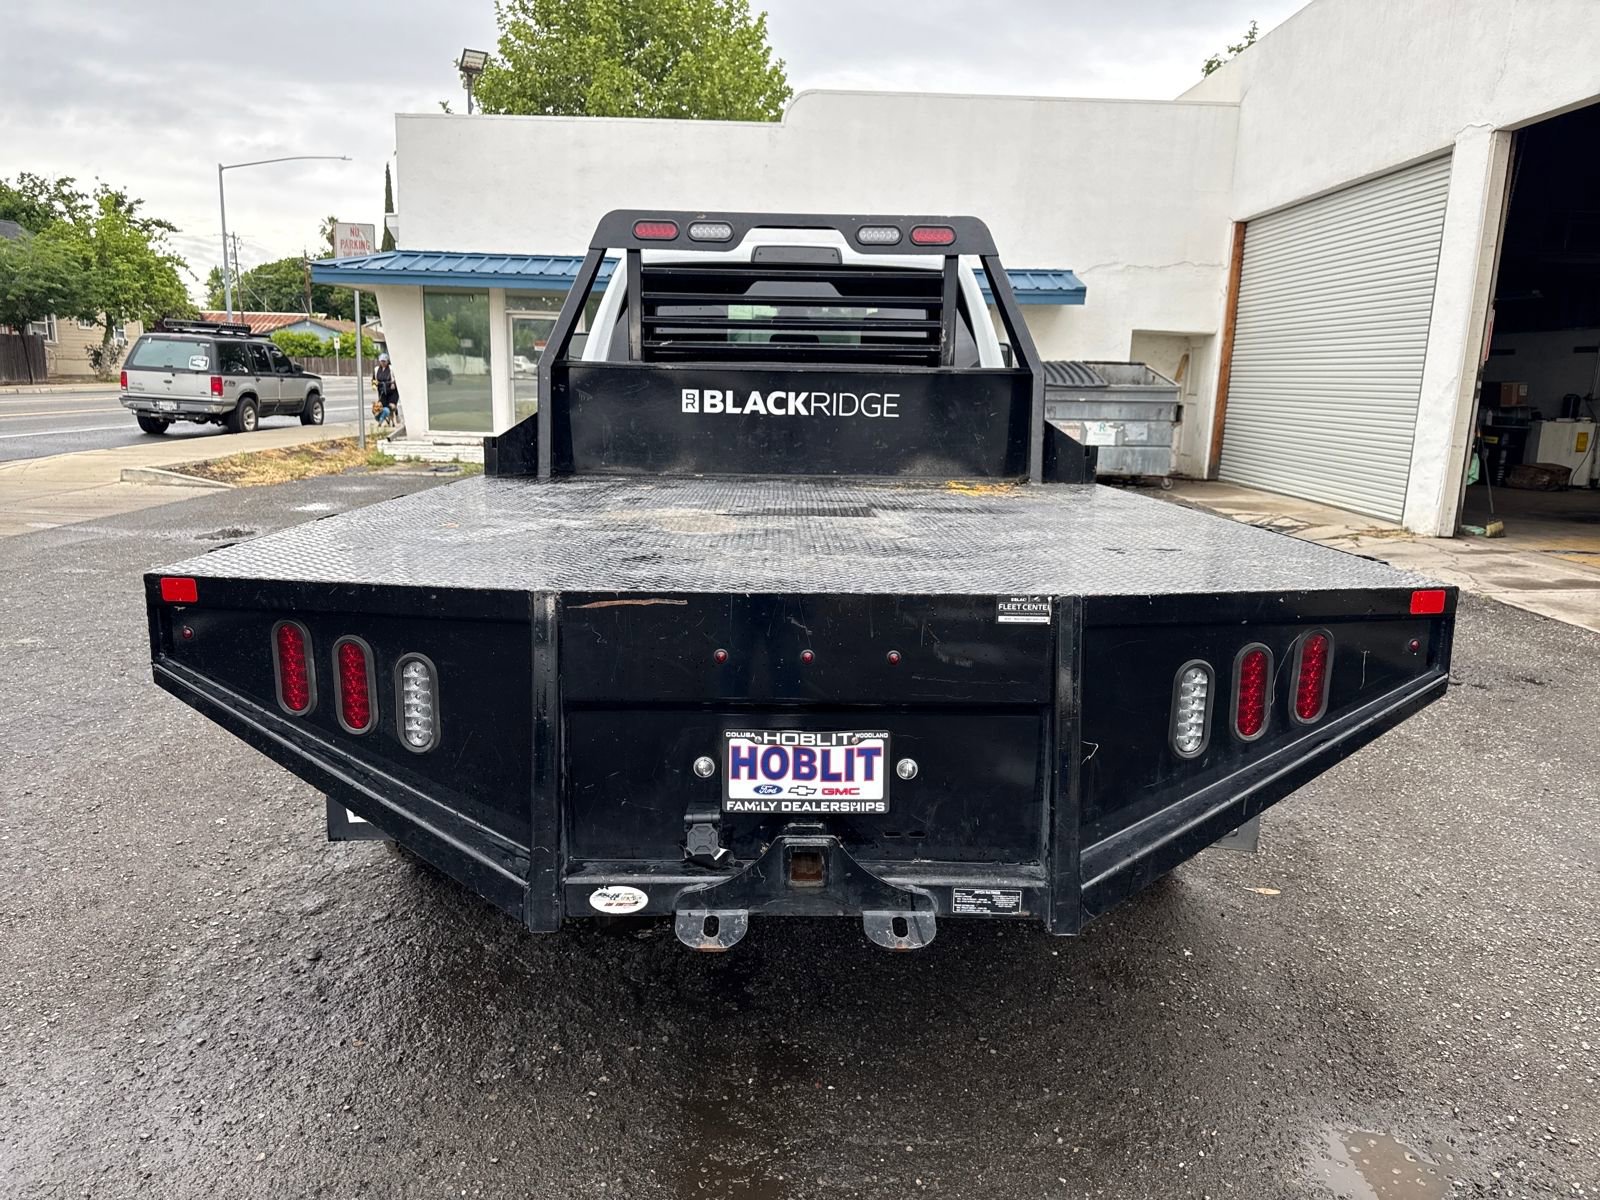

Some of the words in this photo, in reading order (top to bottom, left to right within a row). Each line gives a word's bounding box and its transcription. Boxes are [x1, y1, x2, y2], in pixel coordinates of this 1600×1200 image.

[350, 226, 360, 237] NO
[340, 239, 370, 250] PARKING
[703, 389, 901, 417] BLACKRIDGE
[998, 603, 1021, 611] FLEET
[725, 731, 756, 739] COLUSA
[763, 732, 853, 746] HOBLIT
[730, 745, 883, 782] HOBLIT
[757, 784, 778, 795] Ford
[821, 787, 861, 796] GMC
[781, 801, 886, 812] DEALERSHIPS
